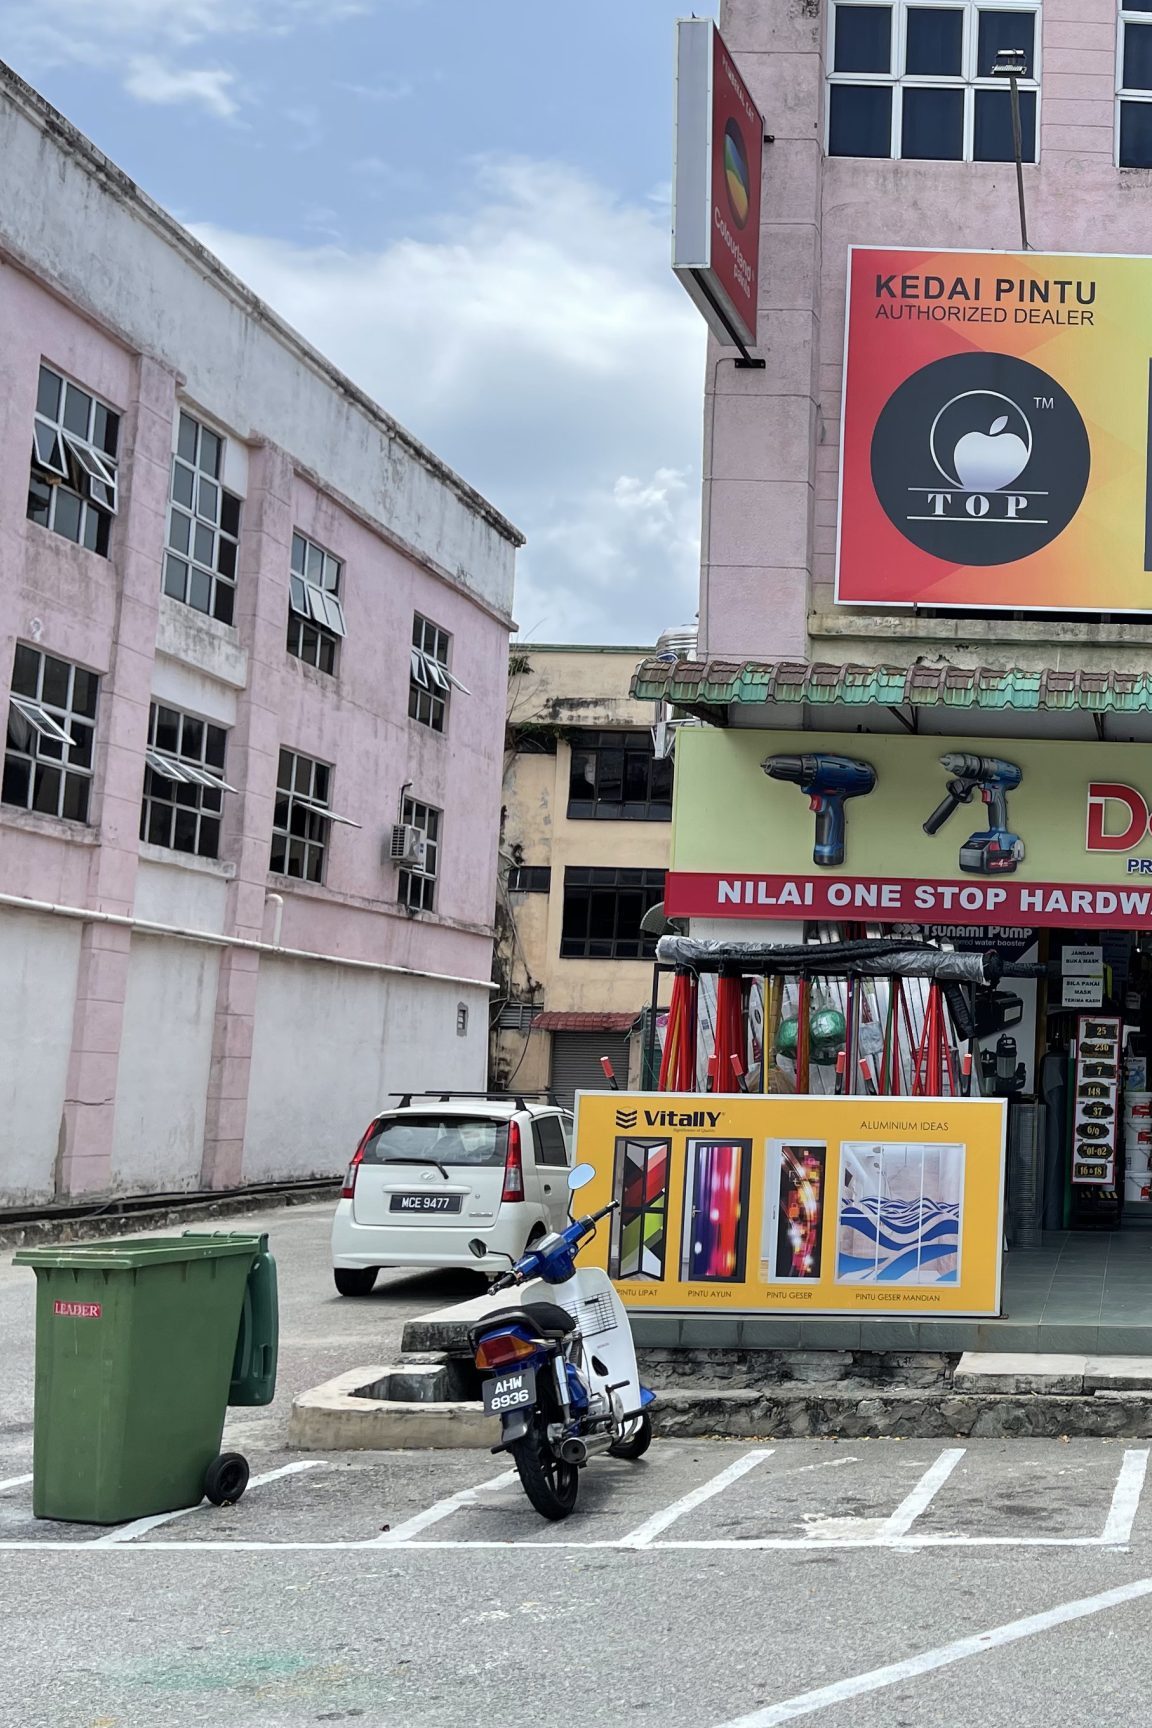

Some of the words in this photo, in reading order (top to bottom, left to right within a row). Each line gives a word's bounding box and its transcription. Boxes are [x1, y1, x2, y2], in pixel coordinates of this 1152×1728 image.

[714, 205, 752, 282] Colourland
[875, 274, 981, 301] KEDAI
[995, 278, 1096, 305] PINTU
[875, 304, 1007, 323] AUTHORIZED
[1014, 308, 1094, 326] DEALER
[1033, 397, 1054, 409] TM
[927, 493, 1028, 518] TOP
[717, 880, 814, 906] NILAI
[827, 882, 902, 908] ONE
[914, 885, 1008, 911] STOP
[1096, 1026, 1107, 1036] 25
[1096, 1066, 1103, 1076] 7
[1088, 1087, 1101, 1096] 148
[1092, 1107, 1103, 1116] 37
[860, 1120, 918, 1132] ALUMINIUM
[919, 1120, 950, 1132] IDEAS
[1094, 1166, 1102, 1176] 18
[401, 1197, 422, 1208] MCE
[423, 1197, 450, 1209] 9477
[616, 1289, 637, 1297] PINTU
[638, 1289, 658, 1297] LIPAT
[687, 1290, 709, 1298] PINTU
[766, 1291, 788, 1299] PINTU
[788, 1292, 813, 1300] GESER
[855, 1293, 876, 1301] PINTU
[877, 1294, 901, 1302] GESER
[902, 1294, 941, 1302] MANDIAN
[55, 1302, 99, 1317] LEADER
[494, 1375, 523, 1395] AHW
[490, 1389, 529, 1410] 8936
